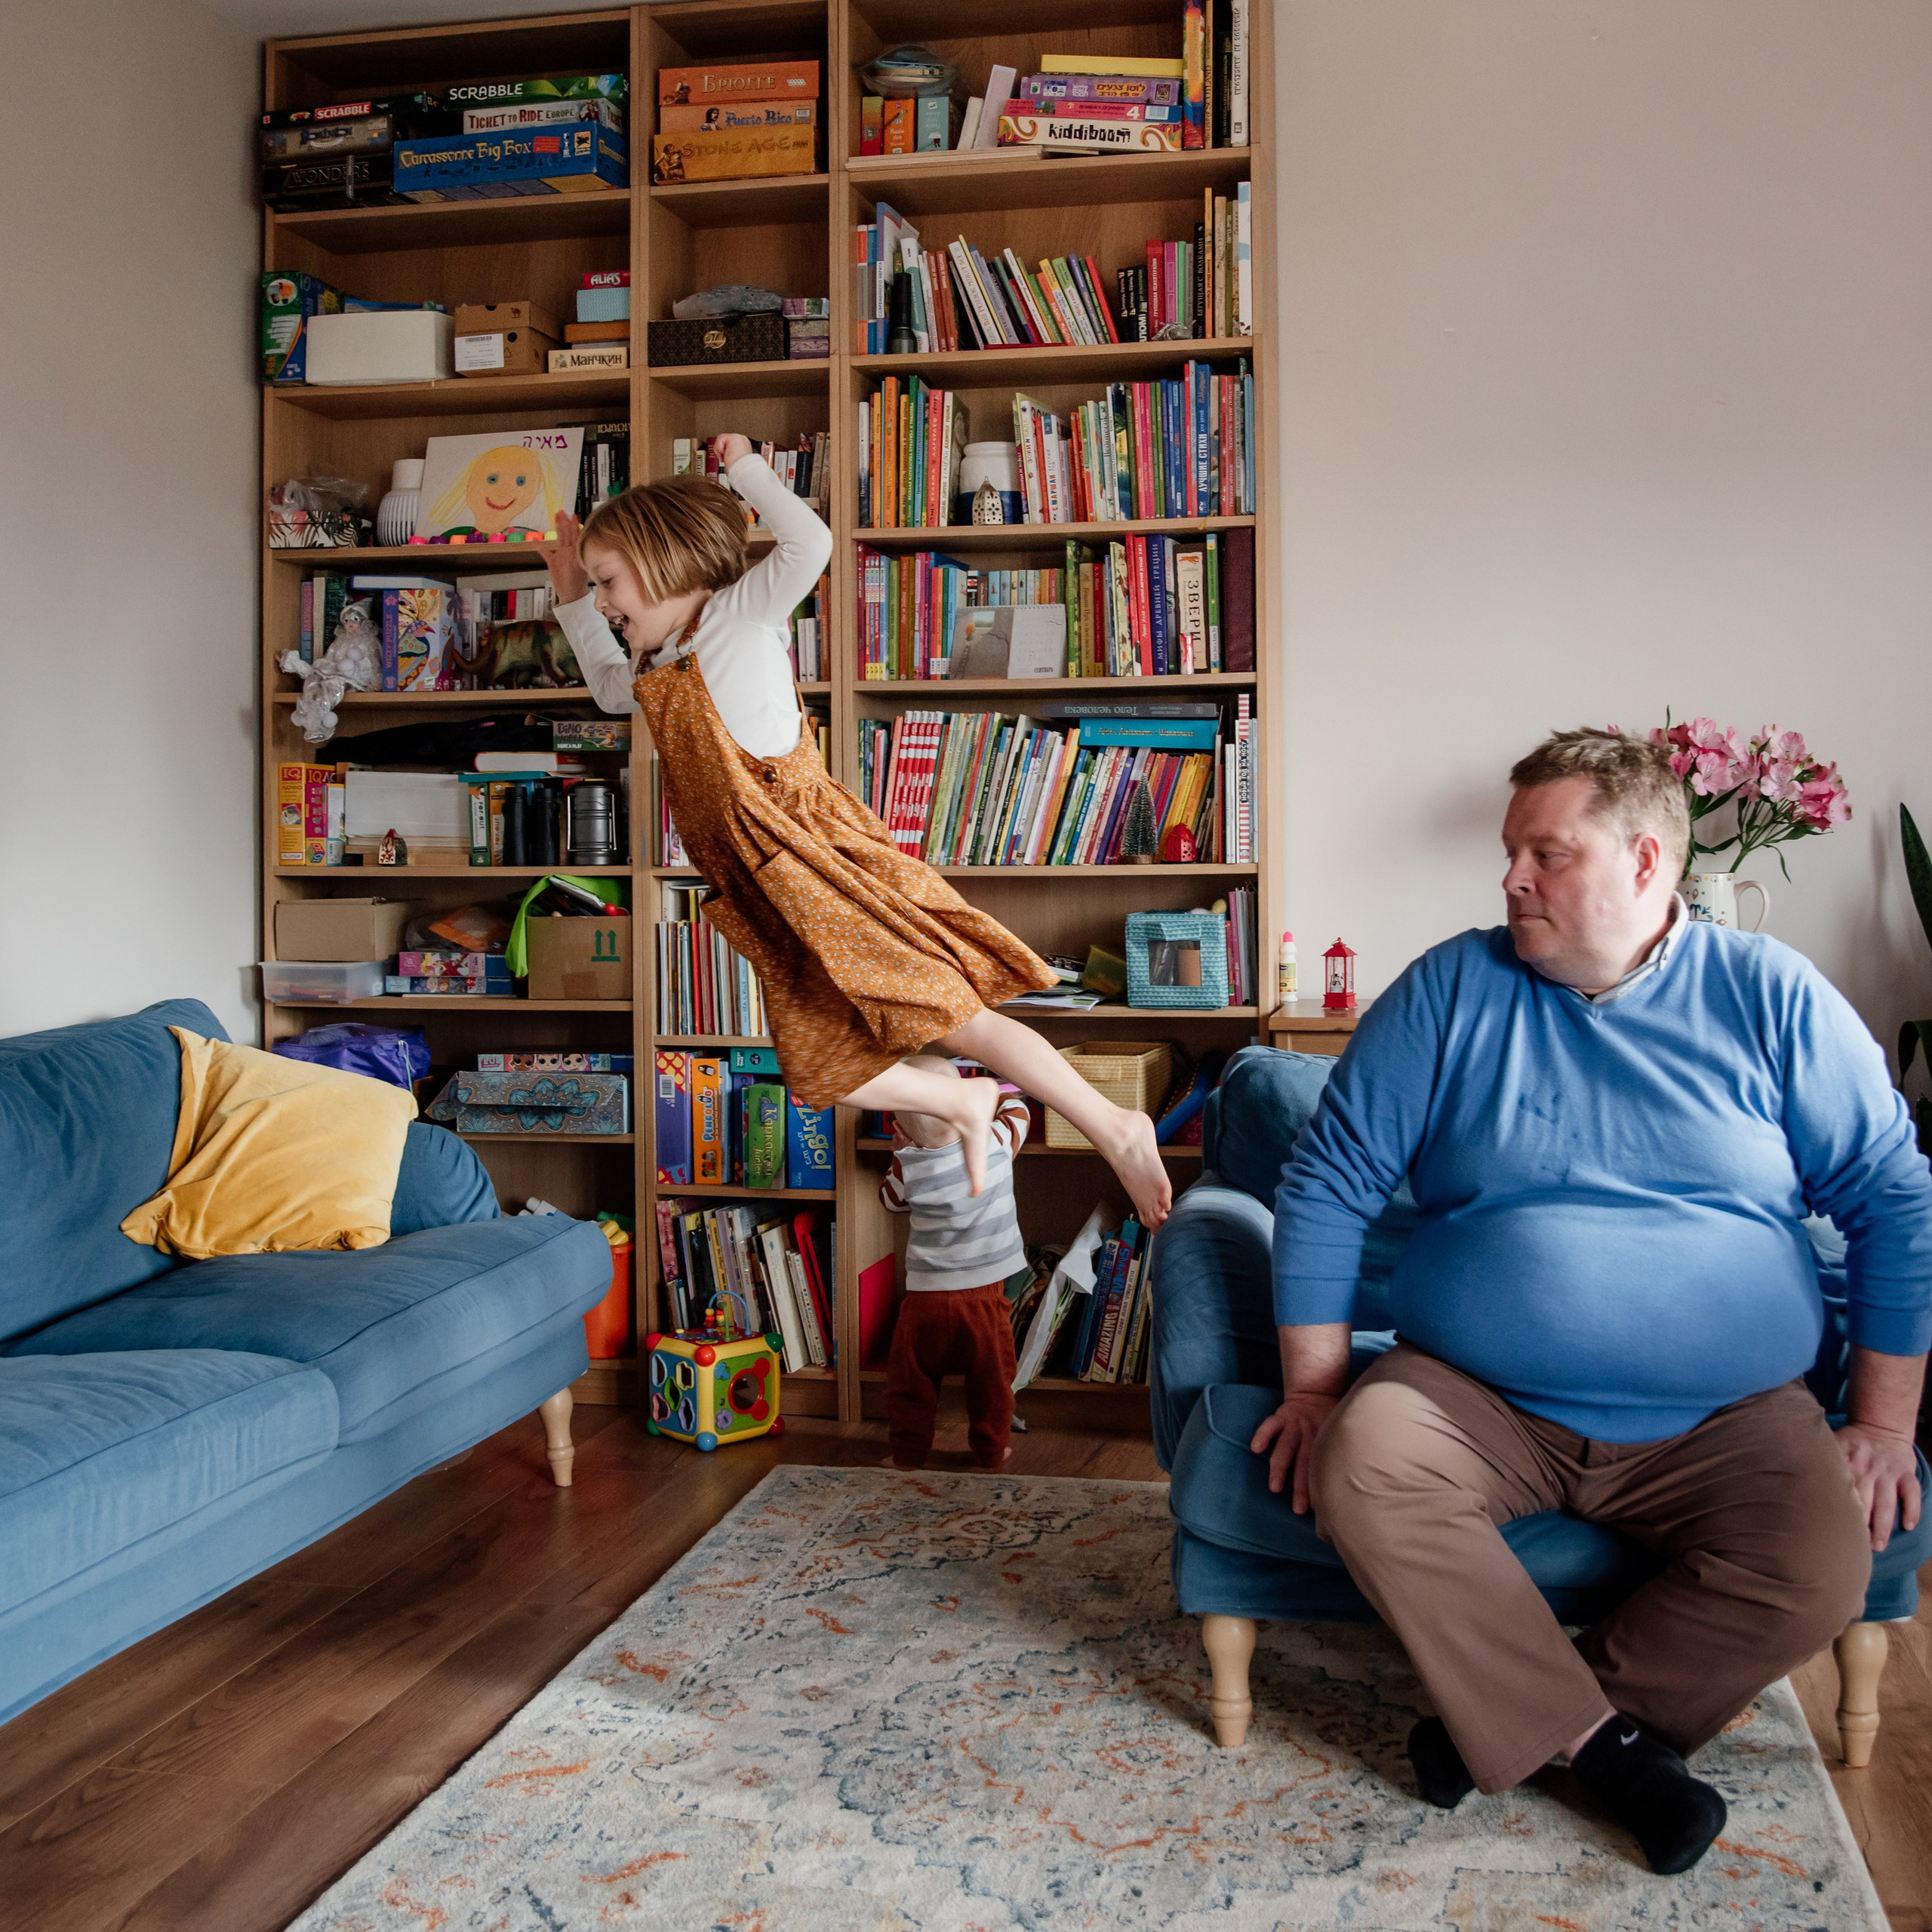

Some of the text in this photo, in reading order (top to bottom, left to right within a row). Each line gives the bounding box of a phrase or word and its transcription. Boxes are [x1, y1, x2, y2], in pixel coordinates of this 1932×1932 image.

[449, 83, 524, 100] SCRABBLE
[701, 75, 778, 94] БРЮГГЕ
[317, 103, 371, 119] SCRABBLE
[469, 109, 574, 130] TICKET TO RIDE EUROPE
[724, 109, 792, 127] Puerto Rico
[1126, 106, 1140, 119] 4
[399, 149, 474, 168] Carcassonne
[475, 142, 501, 162] Big
[503, 140, 532, 154] Box
[680, 136, 791, 159] STONE AGE
[291, 164, 371, 183] WONDRS
[571, 354, 623, 368] Манчкин
[523, 435, 568, 449] מאיה
[1198, 433, 1207, 457] СТИХИ
[1198, 460, 1208, 492] ЛУЧШИЕ
[1048, 474, 1058, 504] МАРШАК
[1152, 543, 1164, 659] МИФЫ ДРЕВНЕЙ ГРЕЦИИ
[1188, 580, 1201, 643] ЗВЕРИ
[1065, 706, 1111, 716] человека
[1113, 706, 1139, 716] Тело
[1241, 758, 1247, 766] НА
[282, 768, 301, 780] IQ
[308, 770, 322, 783] IQ
[484, 1053, 500, 1064] LOL
[796, 1106, 832, 1171] Zingo!
[1097, 1311, 1118, 1364] AMAZING
